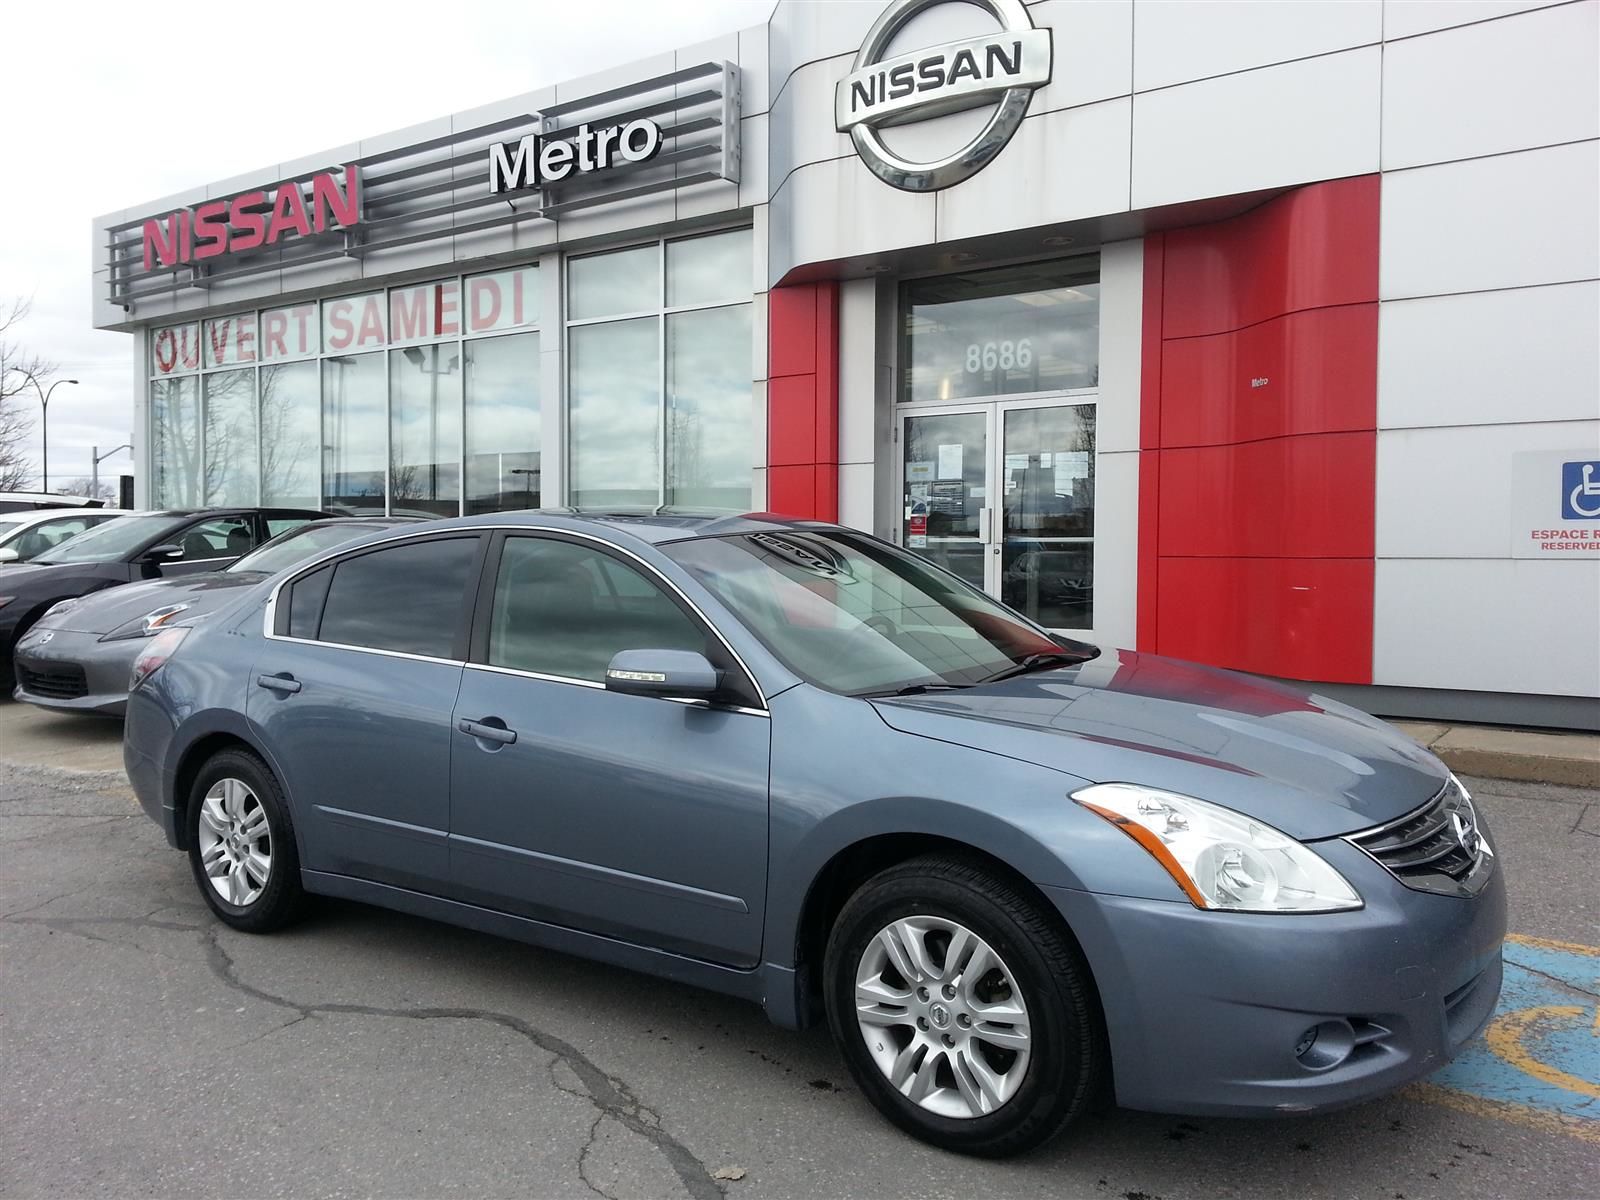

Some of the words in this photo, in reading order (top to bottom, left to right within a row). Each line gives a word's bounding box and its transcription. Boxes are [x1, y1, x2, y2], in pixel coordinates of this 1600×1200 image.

[851, 40, 1022, 113] NISSAN
[489, 118, 660, 193] Metro
[143, 164, 361, 271] NISSAN
[156, 303, 314, 373] OUVERT
[328, 271, 524, 350] SAMEDI
[965, 338, 1032, 374] 8686
[1531, 529, 1589, 540] ESPACE
